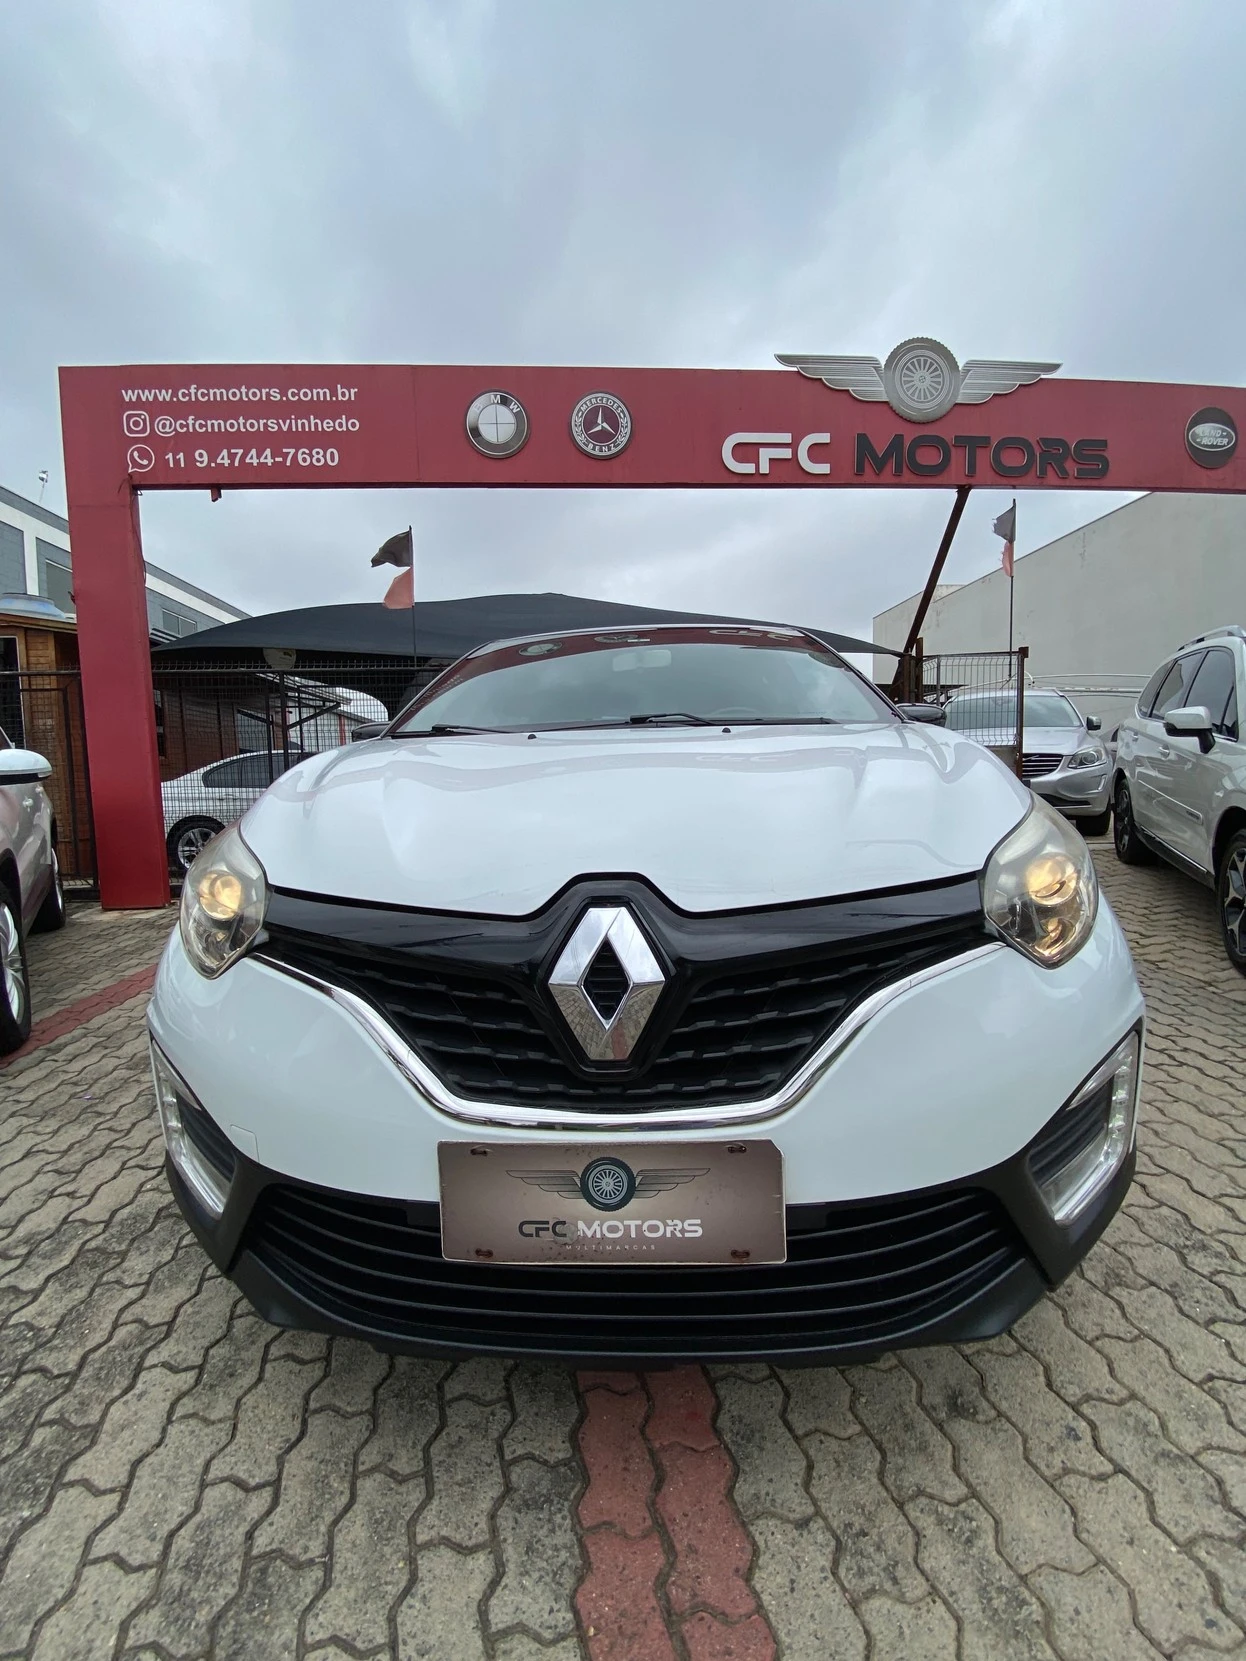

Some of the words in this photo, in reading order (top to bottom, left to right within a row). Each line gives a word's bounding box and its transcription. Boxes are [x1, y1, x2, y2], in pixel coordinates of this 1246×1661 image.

[121, 385, 358, 402] www.cfcmotors.com.br
[580, 396, 622, 413] MERCEDES
[154, 415, 360, 437] @cfcmotorsvinhedo
[587, 443, 616, 453] BENZ
[721, 432, 831, 475] CFC
[855, 432, 1109, 479] MOTORS
[164, 453, 186, 467] 11
[194, 449, 339, 467] 9.4744-7680
[518, 1220, 567, 1238] CFC
[577, 1219, 703, 1239] MOTORS
